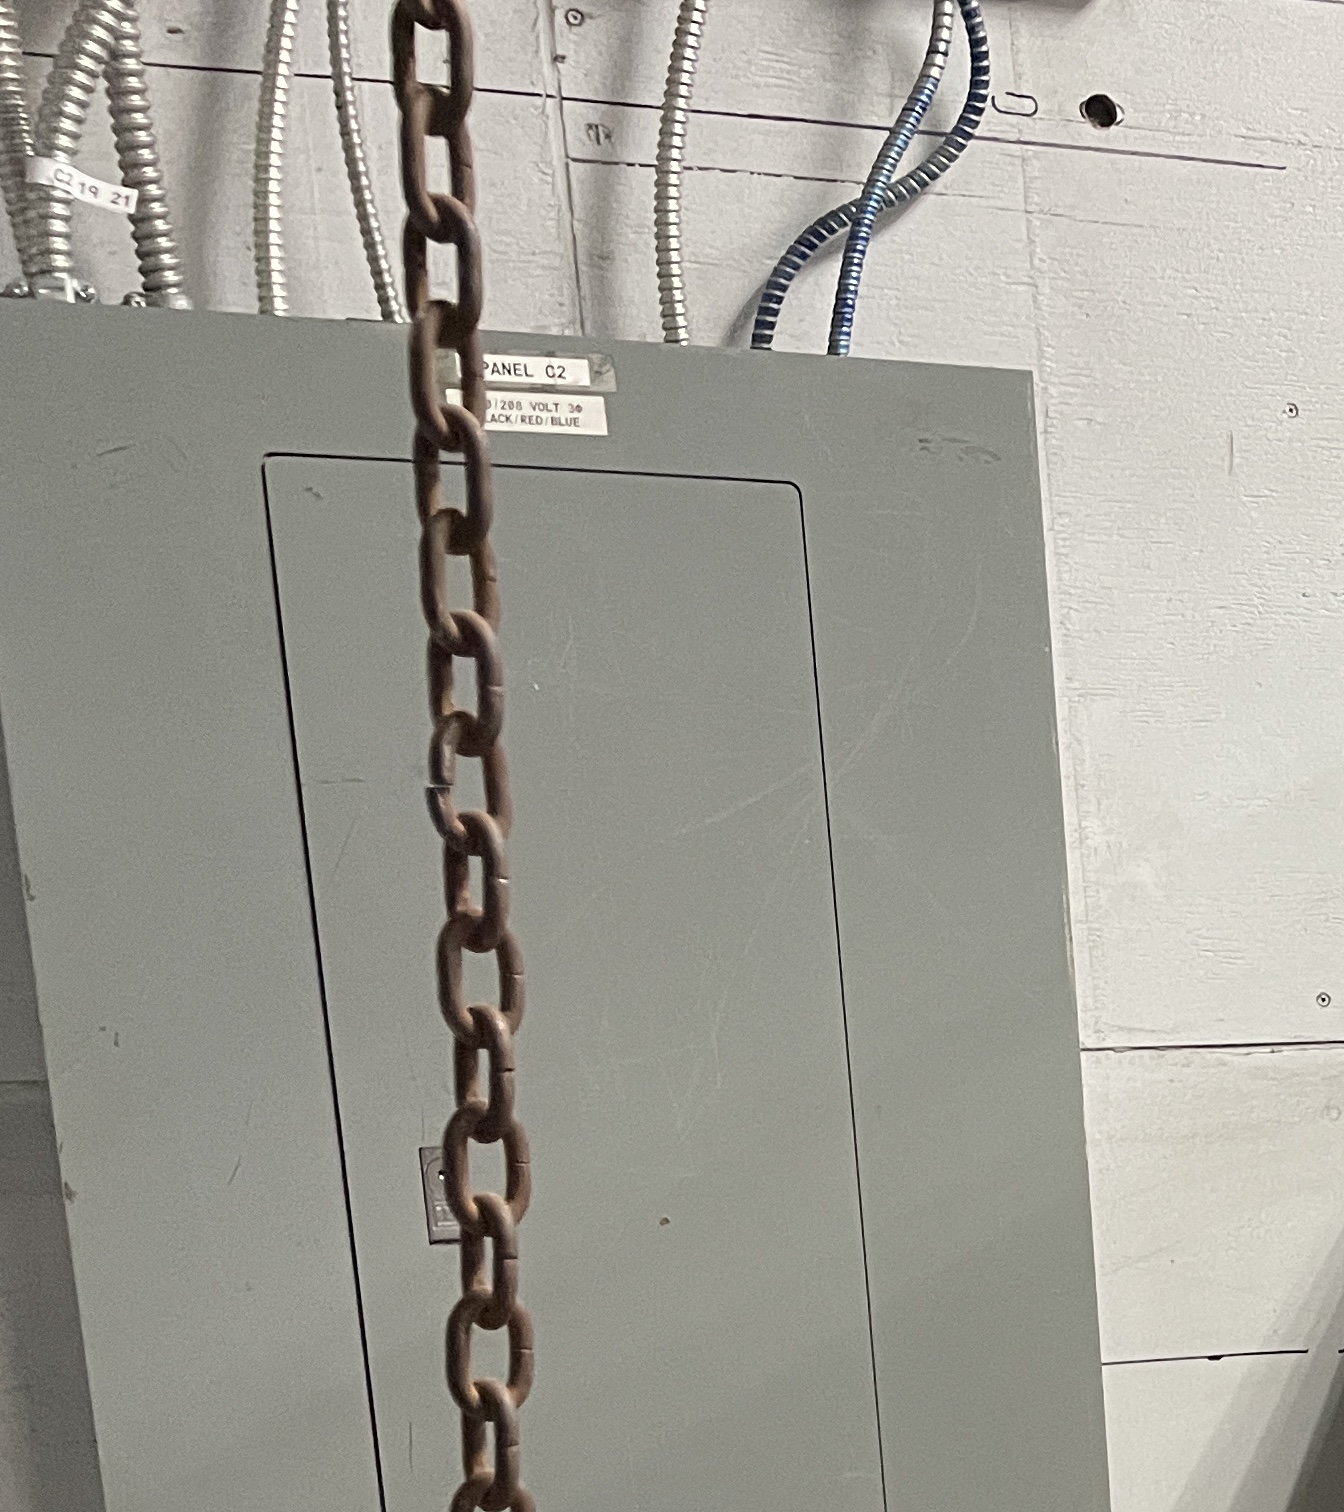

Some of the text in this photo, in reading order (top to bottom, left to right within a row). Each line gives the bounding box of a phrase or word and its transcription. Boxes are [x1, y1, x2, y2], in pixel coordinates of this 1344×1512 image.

[78, 182, 100, 199] 19
[110, 191, 131, 207] 21
[482, 361, 567, 380] PANEL C2
[485, 398, 523, 412] 0/208
[531, 401, 560, 413] VOLT
[486, 413, 581, 428] ACK/RED/BLUE
